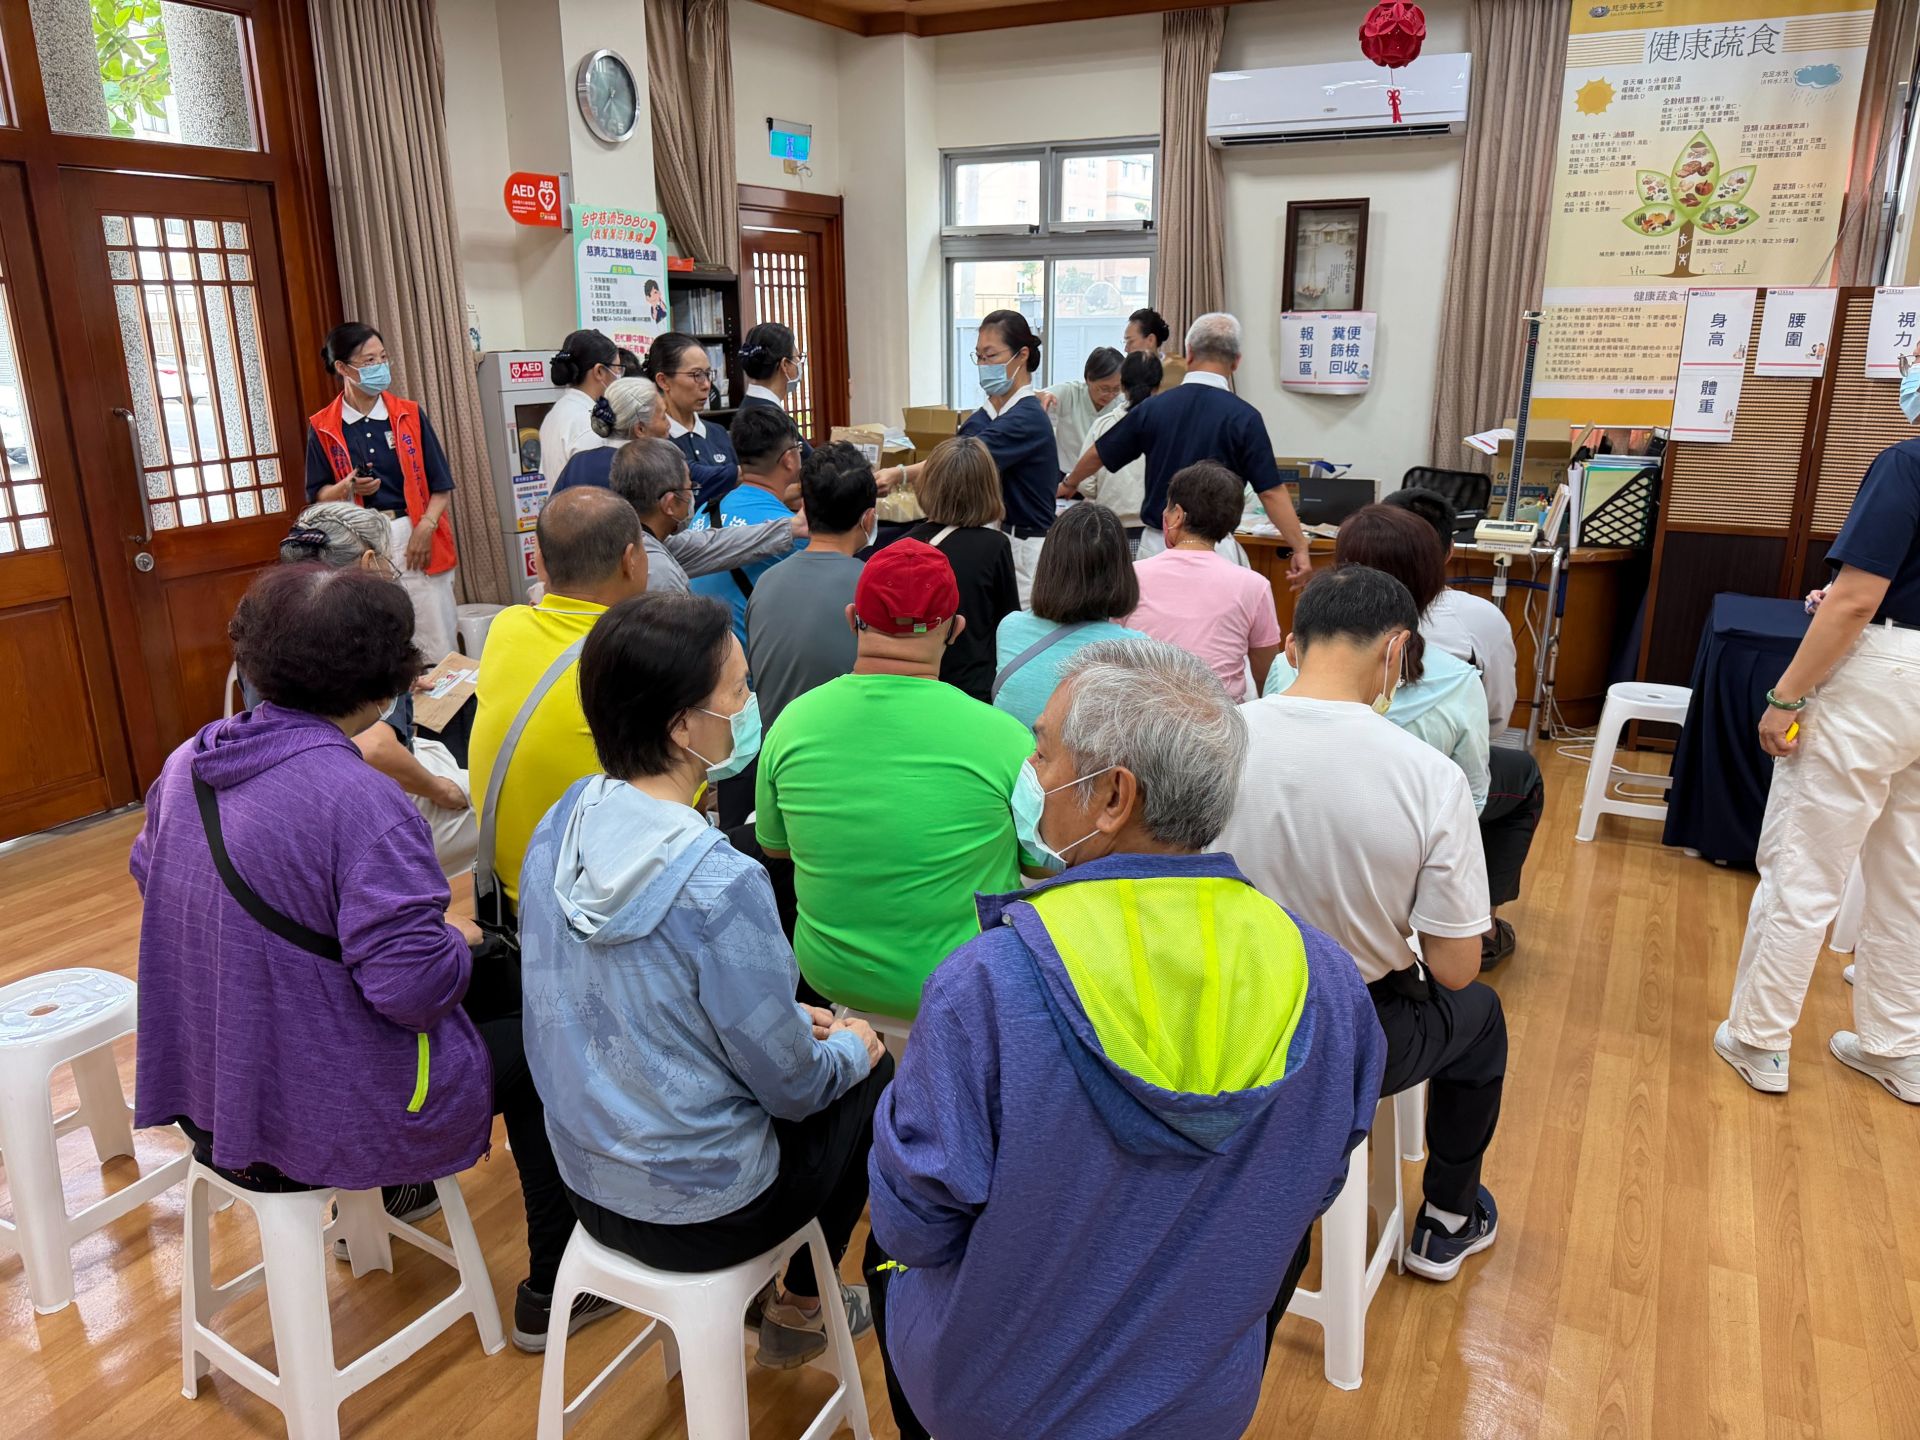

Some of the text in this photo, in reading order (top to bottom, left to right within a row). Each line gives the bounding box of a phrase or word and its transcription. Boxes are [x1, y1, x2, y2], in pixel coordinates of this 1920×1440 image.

[1647, 23, 1781, 64] 健康蔬食
[511, 183, 536, 198] AED
[539, 180, 554, 189] AED
[581, 212, 648, 228] 台中慈濟5880
[1332, 326, 1361, 340] 糞便
[1708, 312, 1728, 347] 身高
[1785, 312, 1806, 347] 腰圍
[1893, 311, 1917, 348] 視力
[1299, 326, 1314, 375] 報到區
[1330, 343, 1360, 358] 篩檢
[522, 362, 542, 372] AED
[1329, 360, 1359, 375] 回收
[1698, 379, 1718, 415] 體重
